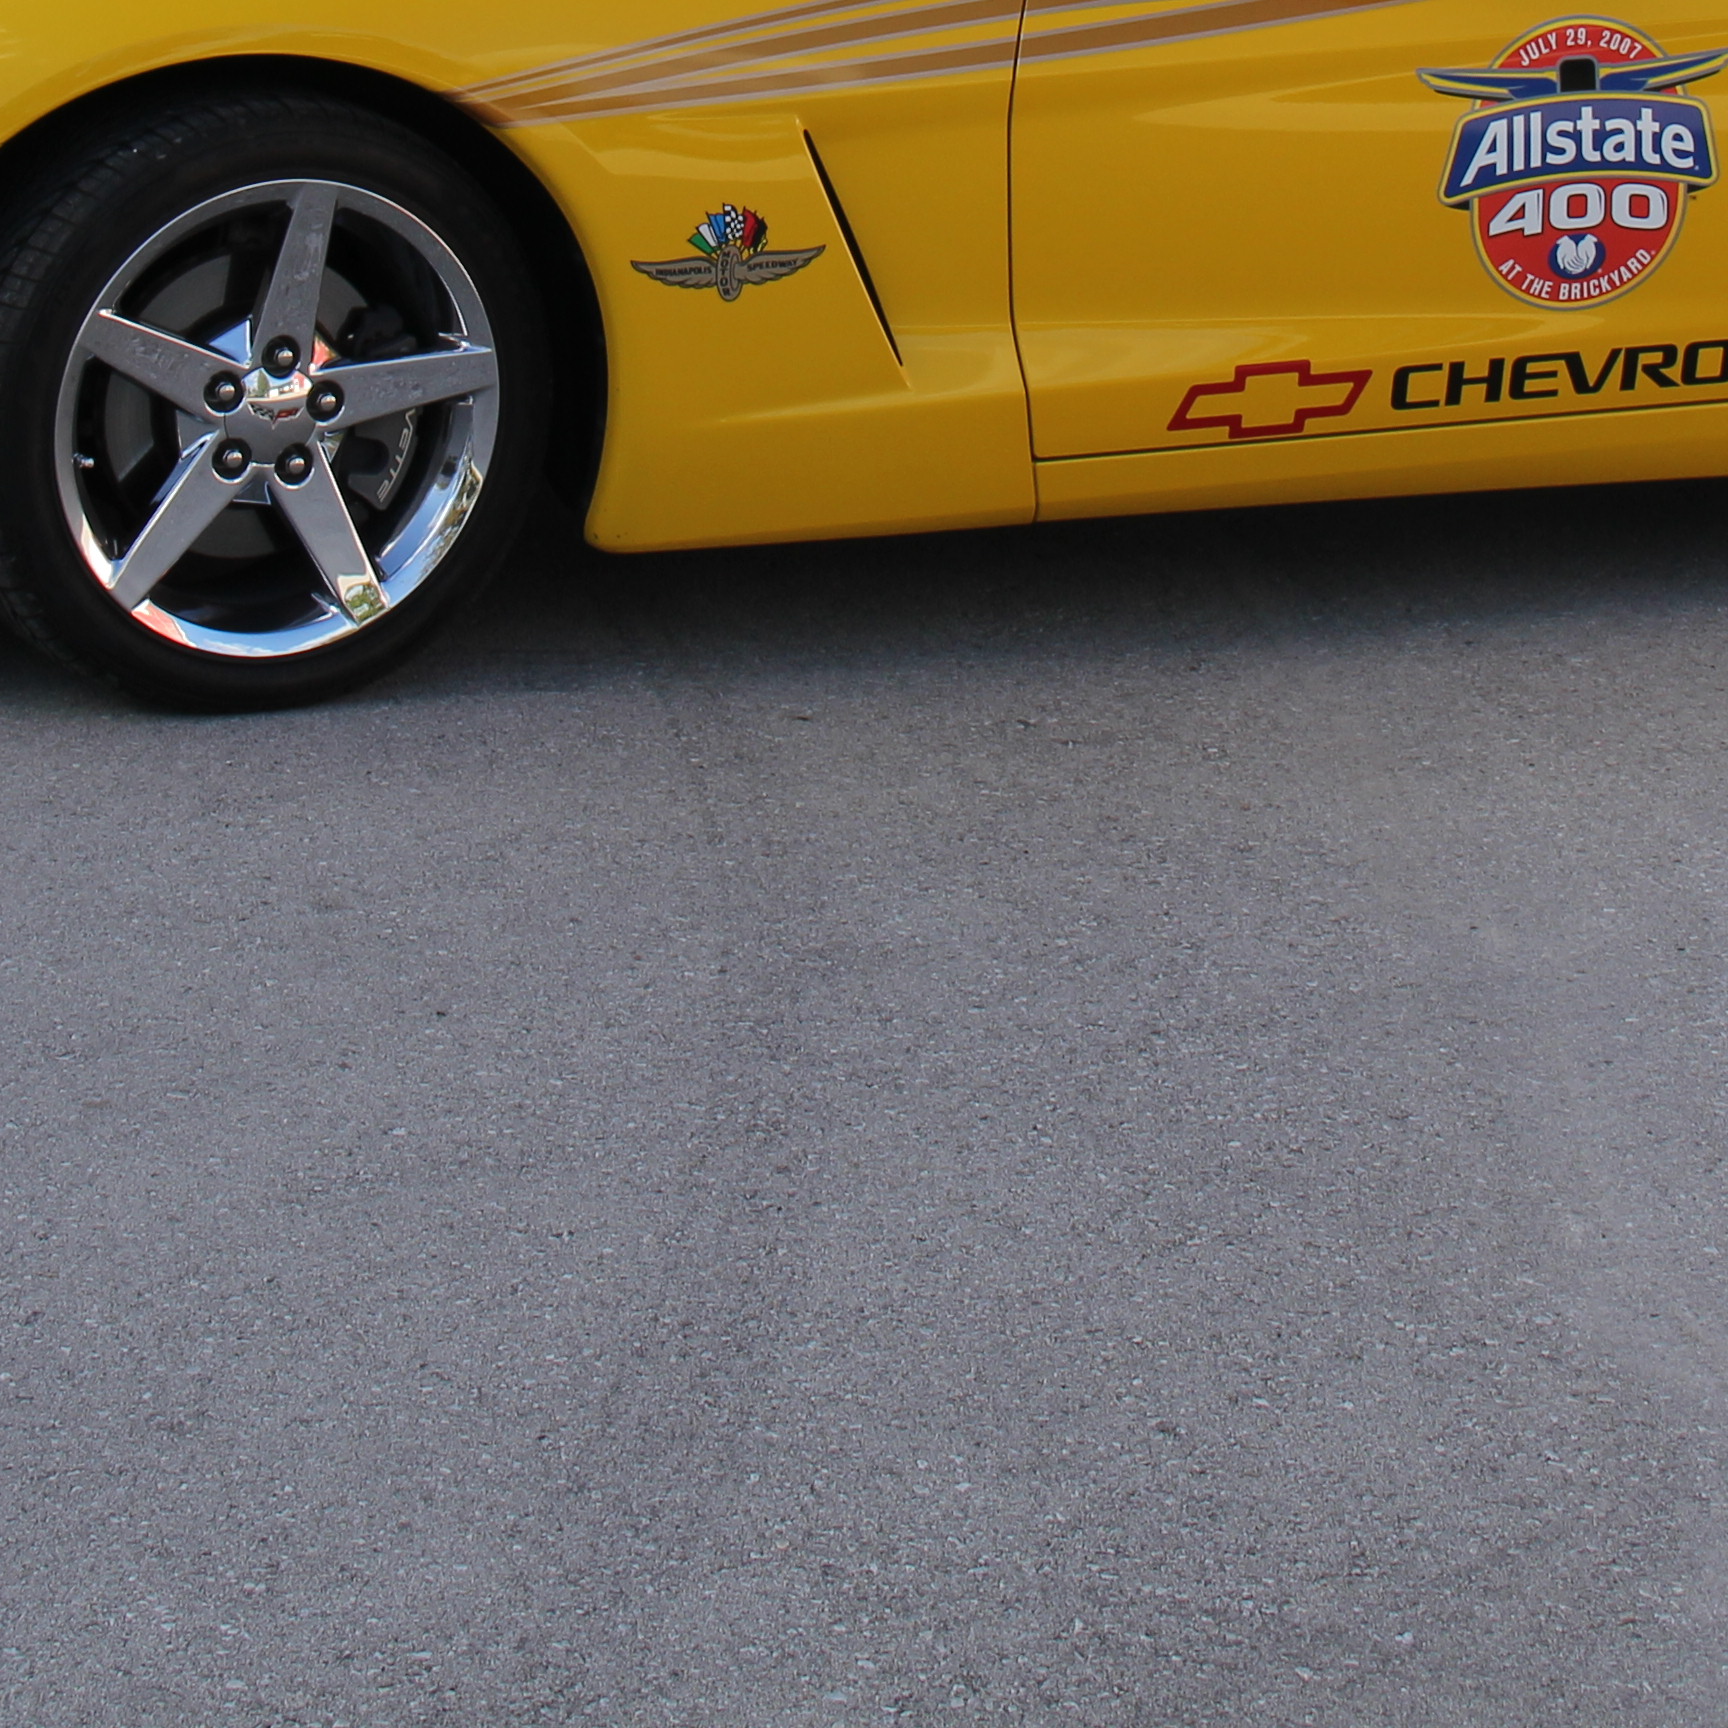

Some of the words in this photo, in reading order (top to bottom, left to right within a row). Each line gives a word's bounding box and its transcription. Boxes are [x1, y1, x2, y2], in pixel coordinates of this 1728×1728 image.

[1519, 32, 1559, 67] JULY
[1566, 27, 1592, 48] 29,
[1599, 30, 1643, 60] 2007
[1460, 106, 1695, 188] Allstate
[1488, 182, 1668, 237] 400
[746, 258, 798, 273] SPEEDWAY
[1498, 258, 1522, 282] AT
[1522, 273, 1553, 300] THE
[1559, 248, 1653, 301] BRICKYARD
[376, 408, 416, 503] VETTE
